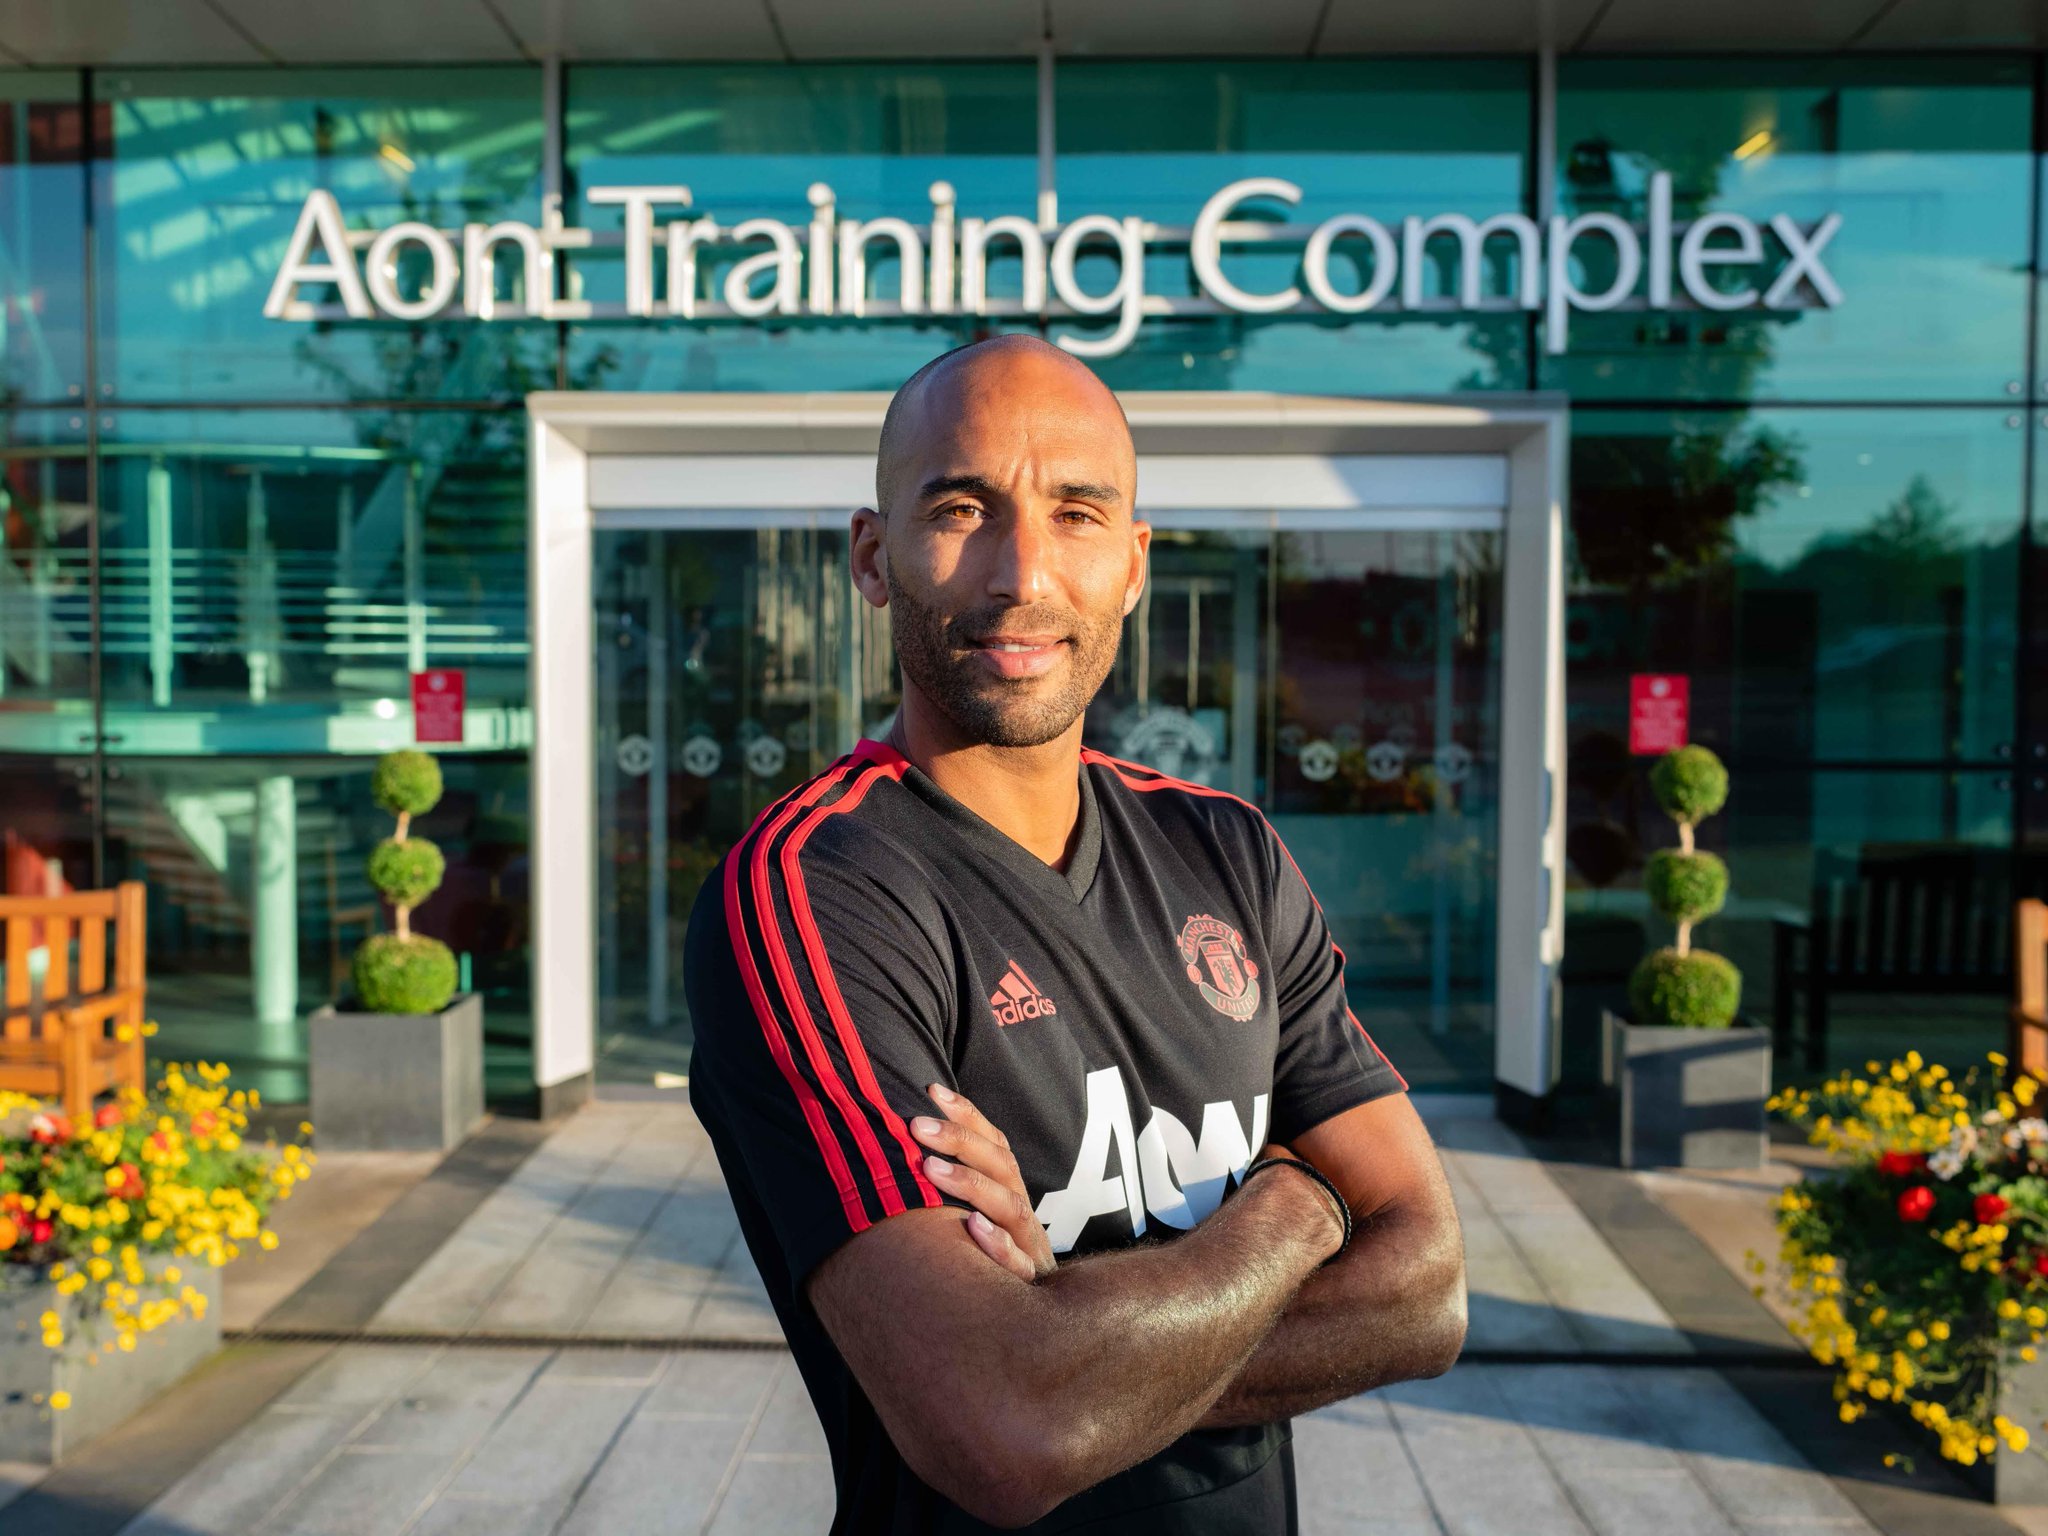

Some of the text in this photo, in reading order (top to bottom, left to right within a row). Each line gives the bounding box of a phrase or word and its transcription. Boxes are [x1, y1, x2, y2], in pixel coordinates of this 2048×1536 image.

[263, 173, 1843, 356] Aon Training Complex
[1184, 921, 1240, 955] MANCHEST
[1216, 995, 1256, 1013] UNITED
